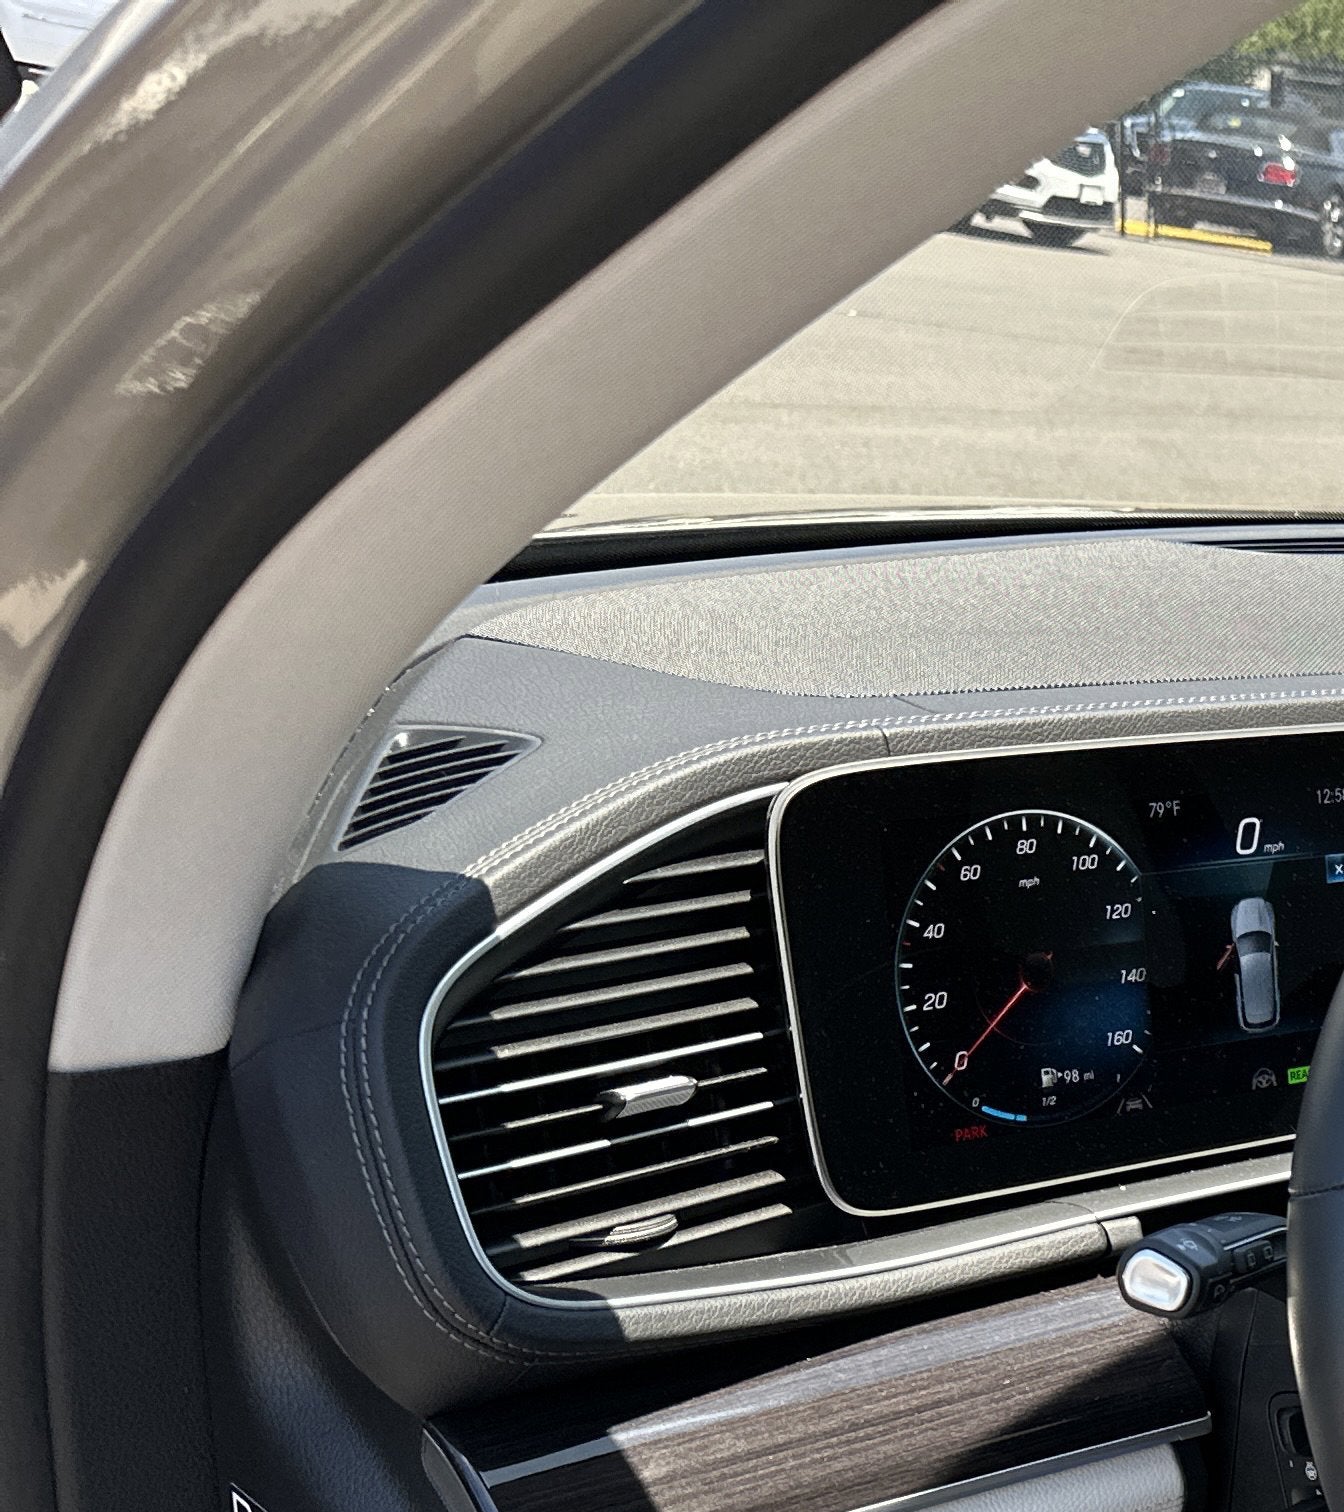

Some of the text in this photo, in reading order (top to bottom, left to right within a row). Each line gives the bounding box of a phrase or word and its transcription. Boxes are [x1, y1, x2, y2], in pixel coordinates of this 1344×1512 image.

[1149, 800, 1181, 818] 79°F
[1235, 816, 1285, 855] 0 mph
[1016, 838, 1037, 855] 80
[1071, 854, 1099, 872] 100
[959, 864, 981, 881] 60
[1018, 875, 1040, 889] mph
[1105, 902, 1132, 920] 120
[923, 922, 945, 940] 40
[1119, 967, 1147, 984] 140
[922, 991, 948, 1011] 20
[1106, 1029, 1133, 1047] 160
[953, 1050, 969, 1071] 0
[1063, 1069, 1080, 1084] 98
[971, 1097, 980, 1108] 0
[1042, 1095, 1057, 1107] 1/2
[953, 1124, 989, 1142] PARK
